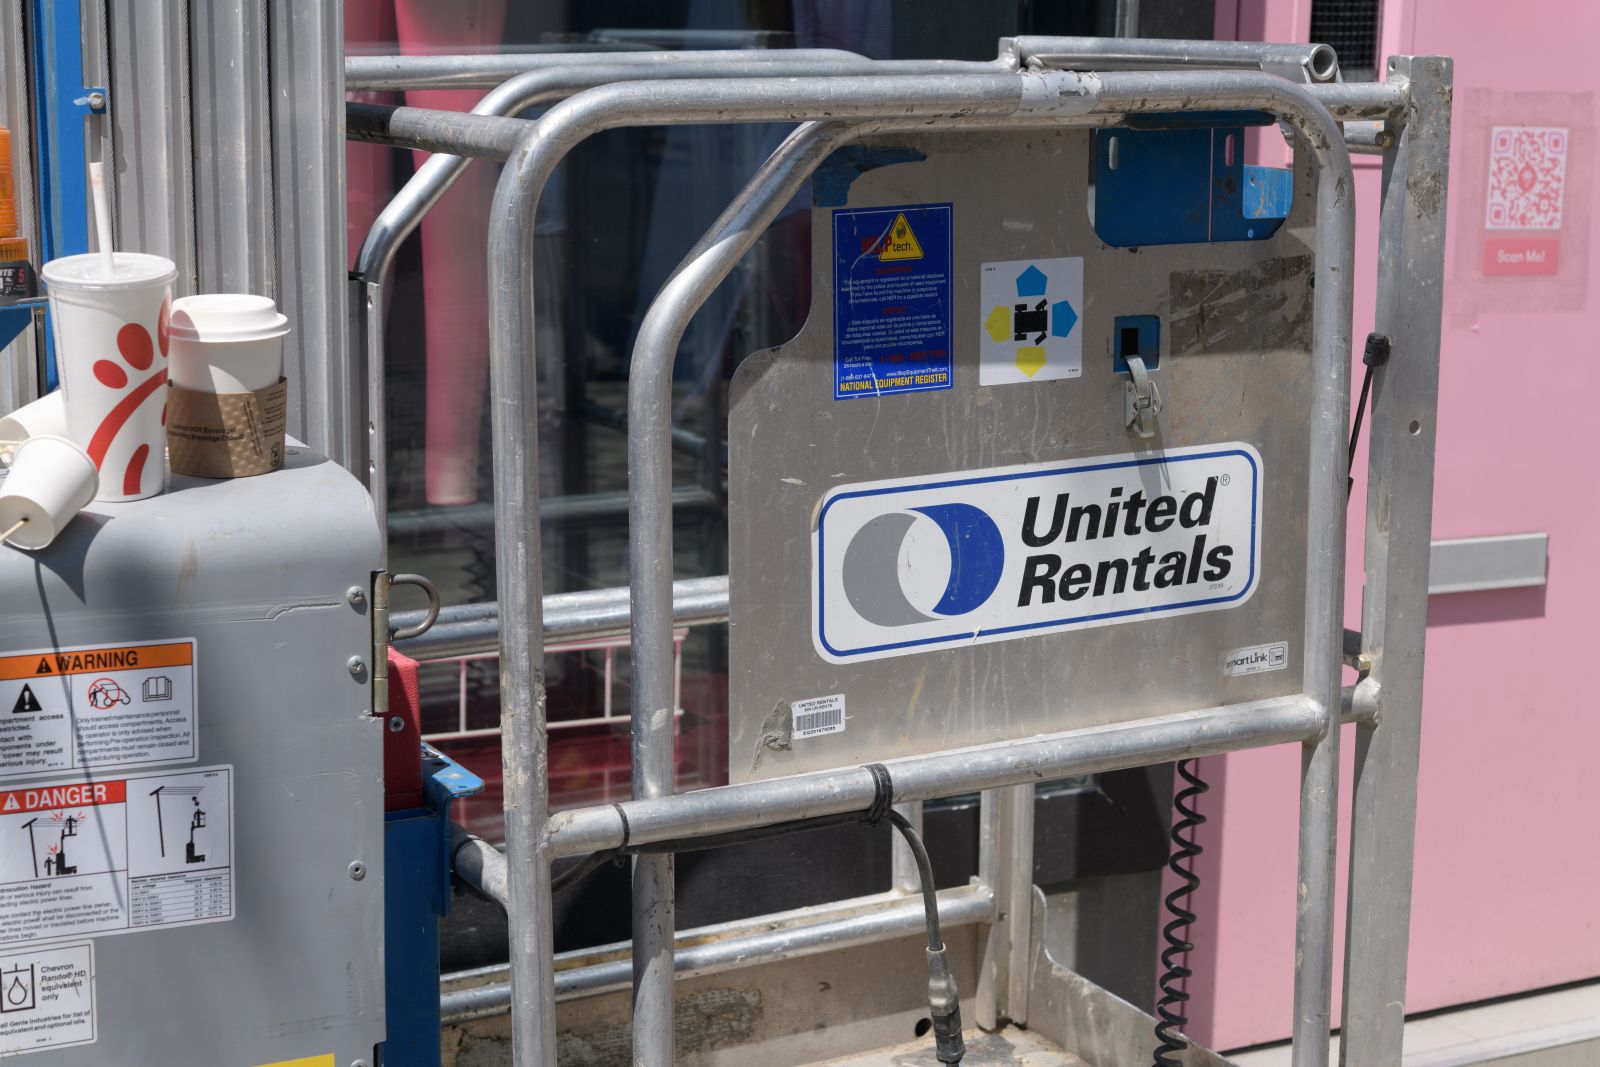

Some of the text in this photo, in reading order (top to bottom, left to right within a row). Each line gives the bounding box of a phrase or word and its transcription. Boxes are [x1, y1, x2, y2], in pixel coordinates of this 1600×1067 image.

[1497, 249, 1545, 263] Scan Me!
[840, 373, 947, 392] NATIONAL EQUIPMENT REGISTER
[1021, 475, 1219, 548] United
[1017, 534, 1234, 608] Rentals
[56, 650, 139, 672] WARNING
[0, 724, 31, 732] estricted.
[25, 784, 107, 809] DANGER
[41, 963, 74, 974] Chevron
[42, 980, 82, 992] equivalent
[42, 993, 59, 1001] only
[30, 1016, 62, 1024] Industries
[47, 1020, 73, 1030] optional
